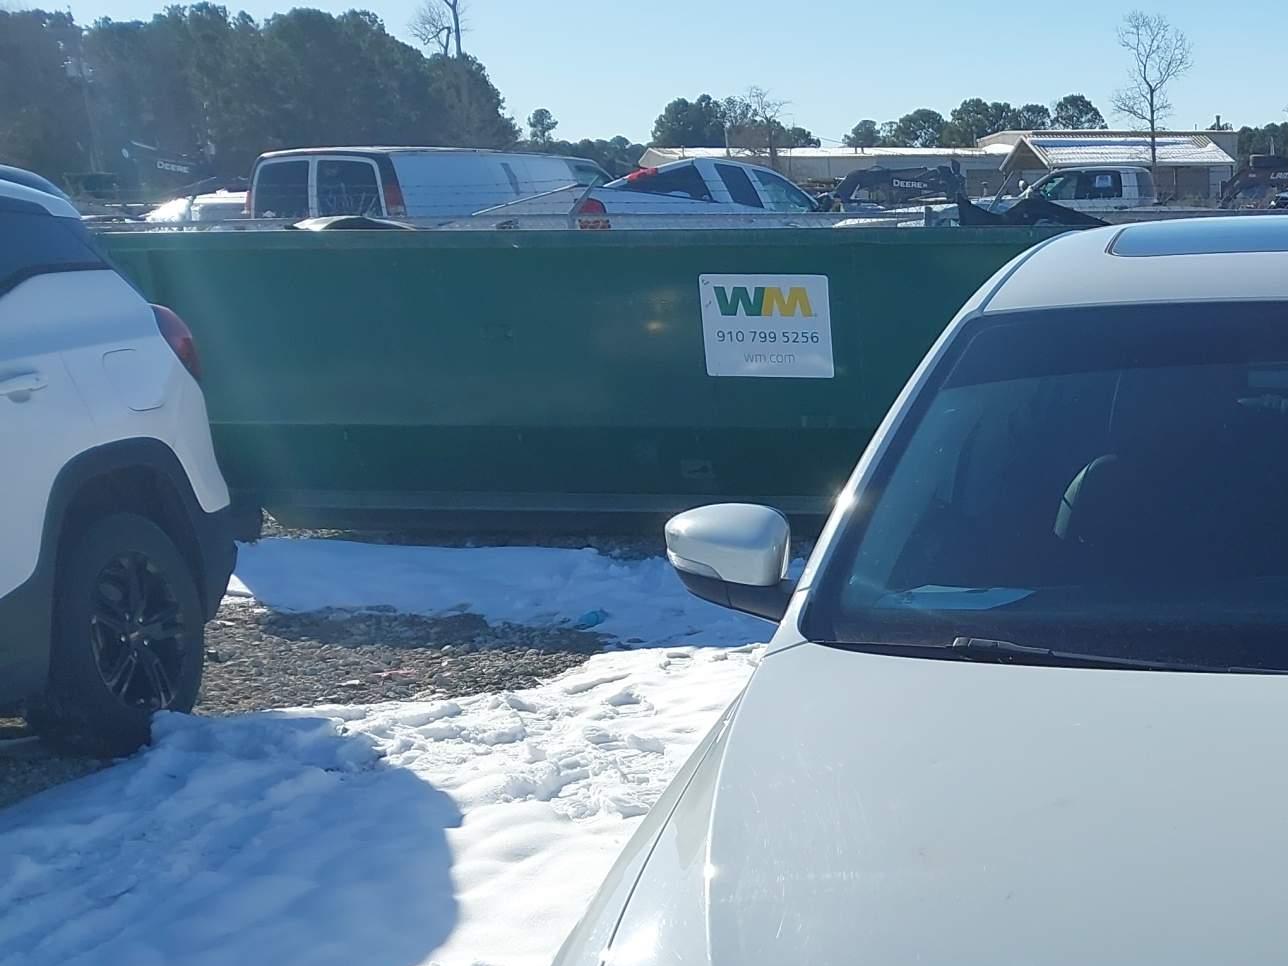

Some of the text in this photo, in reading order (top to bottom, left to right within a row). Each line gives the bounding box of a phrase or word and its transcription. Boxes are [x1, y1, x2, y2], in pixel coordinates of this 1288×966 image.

[156, 161, 190, 173] DEERE
[893, 179, 923, 189] DEERE
[713, 286, 814, 317] WM
[716, 330, 820, 344] 910 799 5256
[744, 353, 796, 364] wm.com
